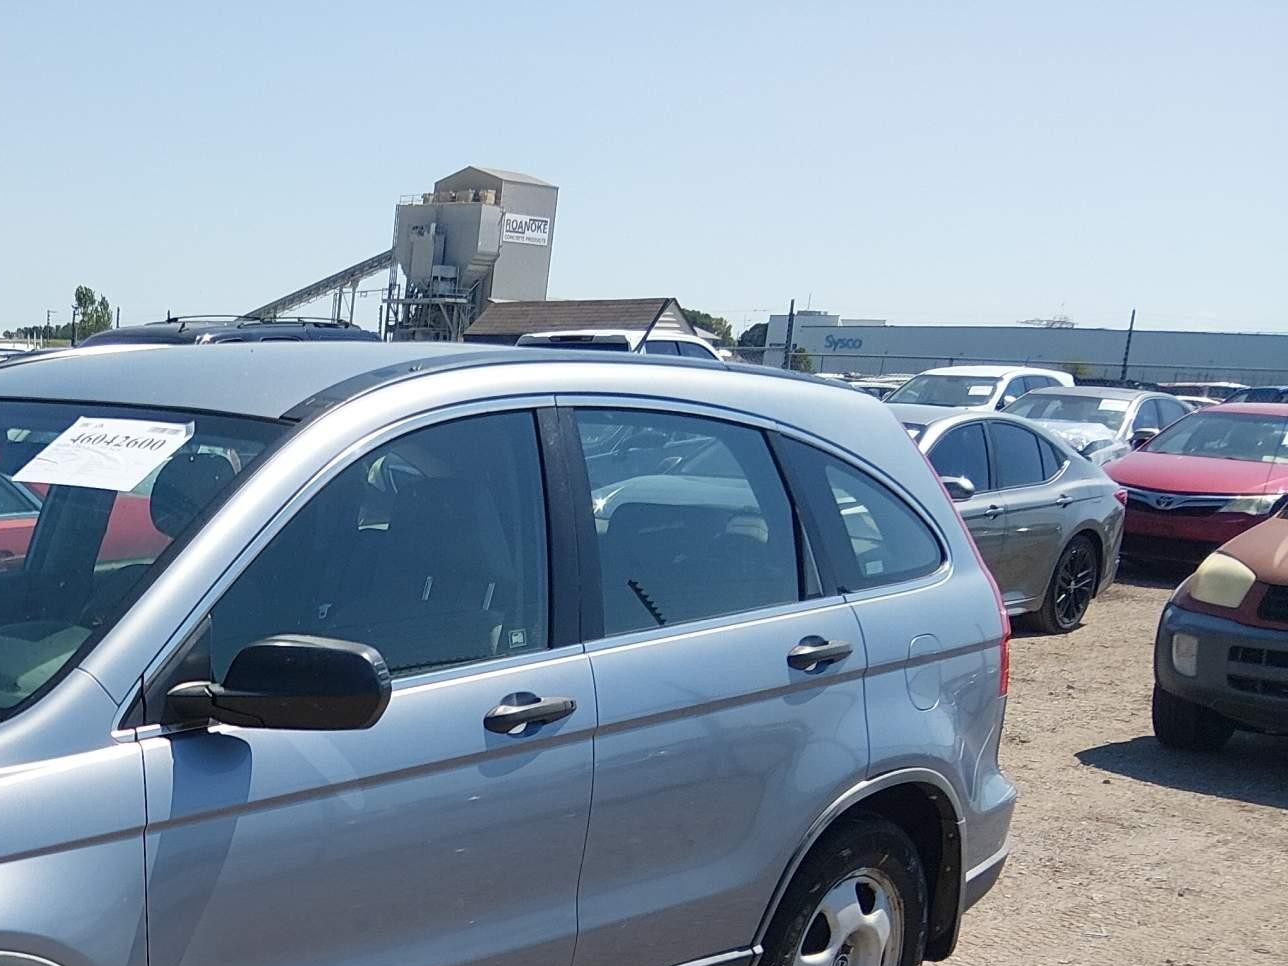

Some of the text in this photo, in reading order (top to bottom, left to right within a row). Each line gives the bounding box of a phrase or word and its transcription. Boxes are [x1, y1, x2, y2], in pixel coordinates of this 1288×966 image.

[505, 218, 548, 234] ROANOKE
[824, 334, 863, 352] Sysco
[70, 432, 167, 451] 46042600
